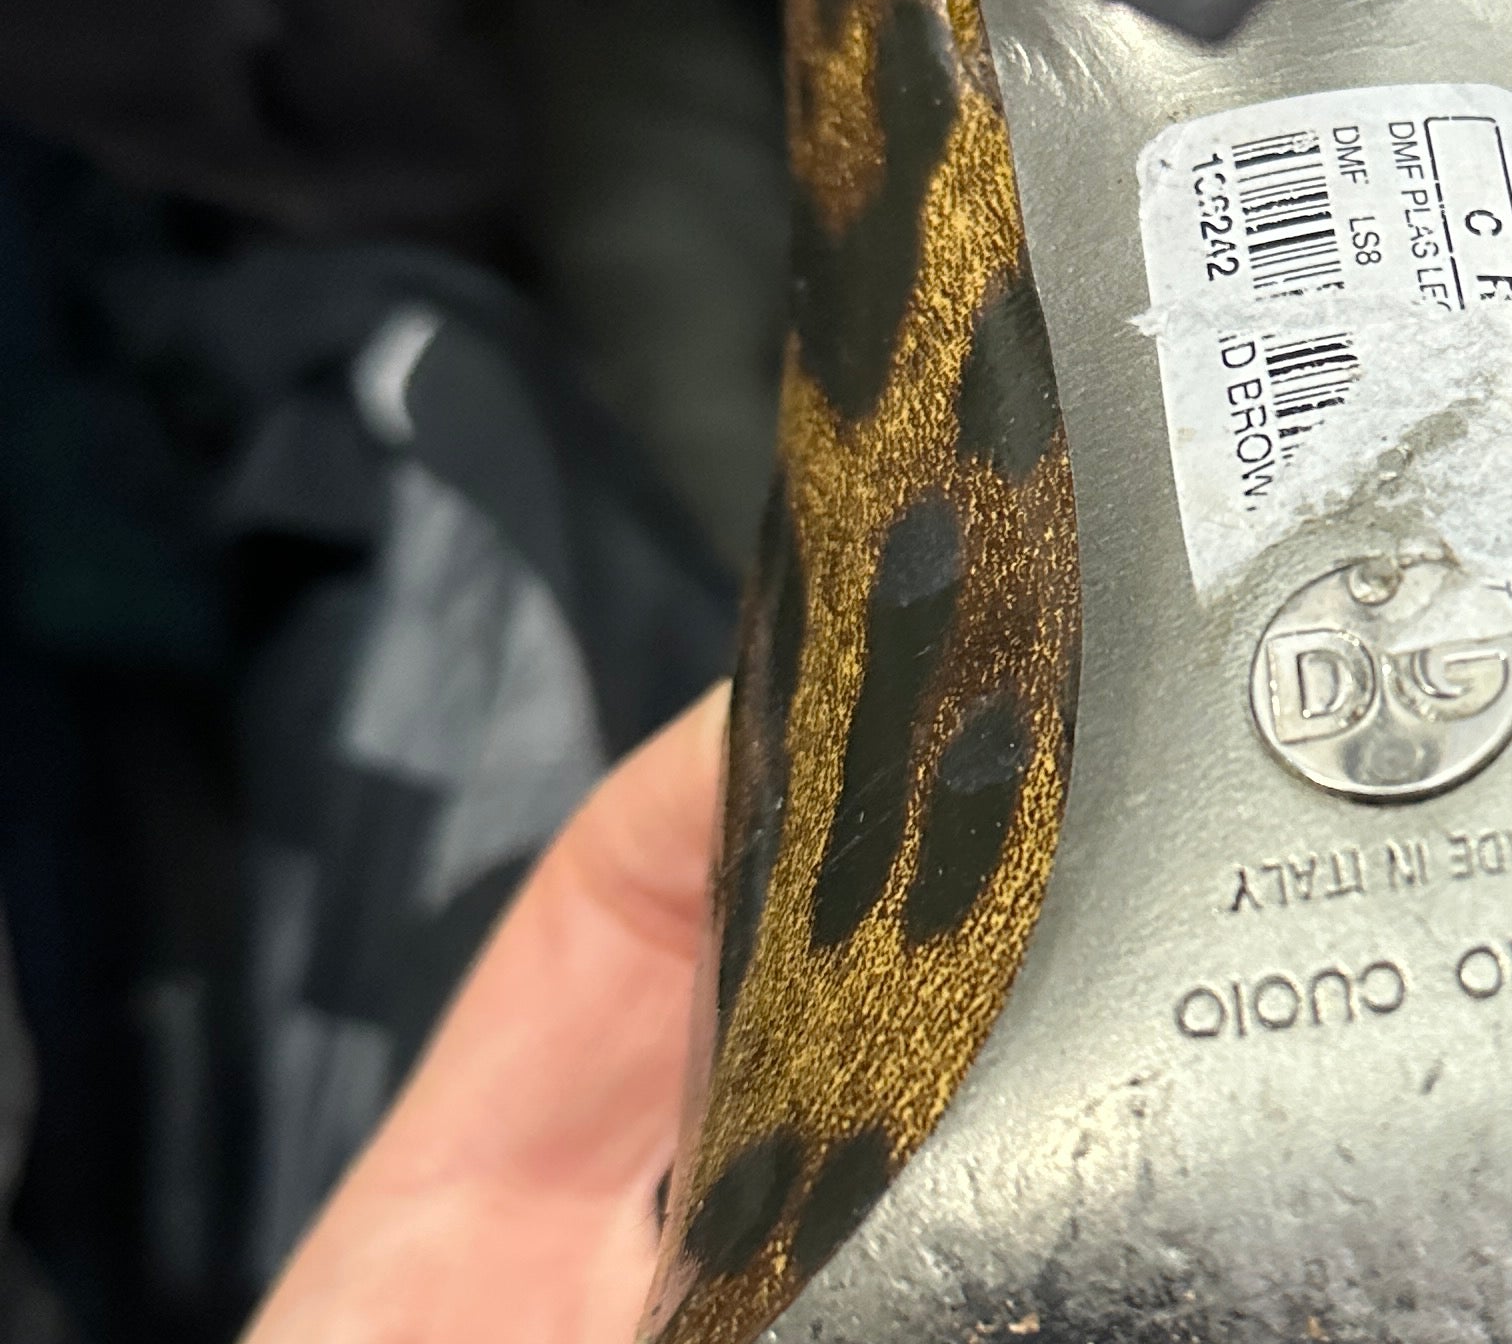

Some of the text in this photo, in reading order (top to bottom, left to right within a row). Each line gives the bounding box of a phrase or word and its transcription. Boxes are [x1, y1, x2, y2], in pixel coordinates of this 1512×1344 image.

[1388, 121, 1425, 180] DMF
[1332, 125, 1382, 265] DMF LS8
[1400, 189, 1441, 259] PLAS
[1226, 378, 1276, 512] BROW
[1231, 846, 1365, 913] ITALY
[1385, 838, 1429, 889] IN
[1174, 960, 1406, 1038] CUOIO
